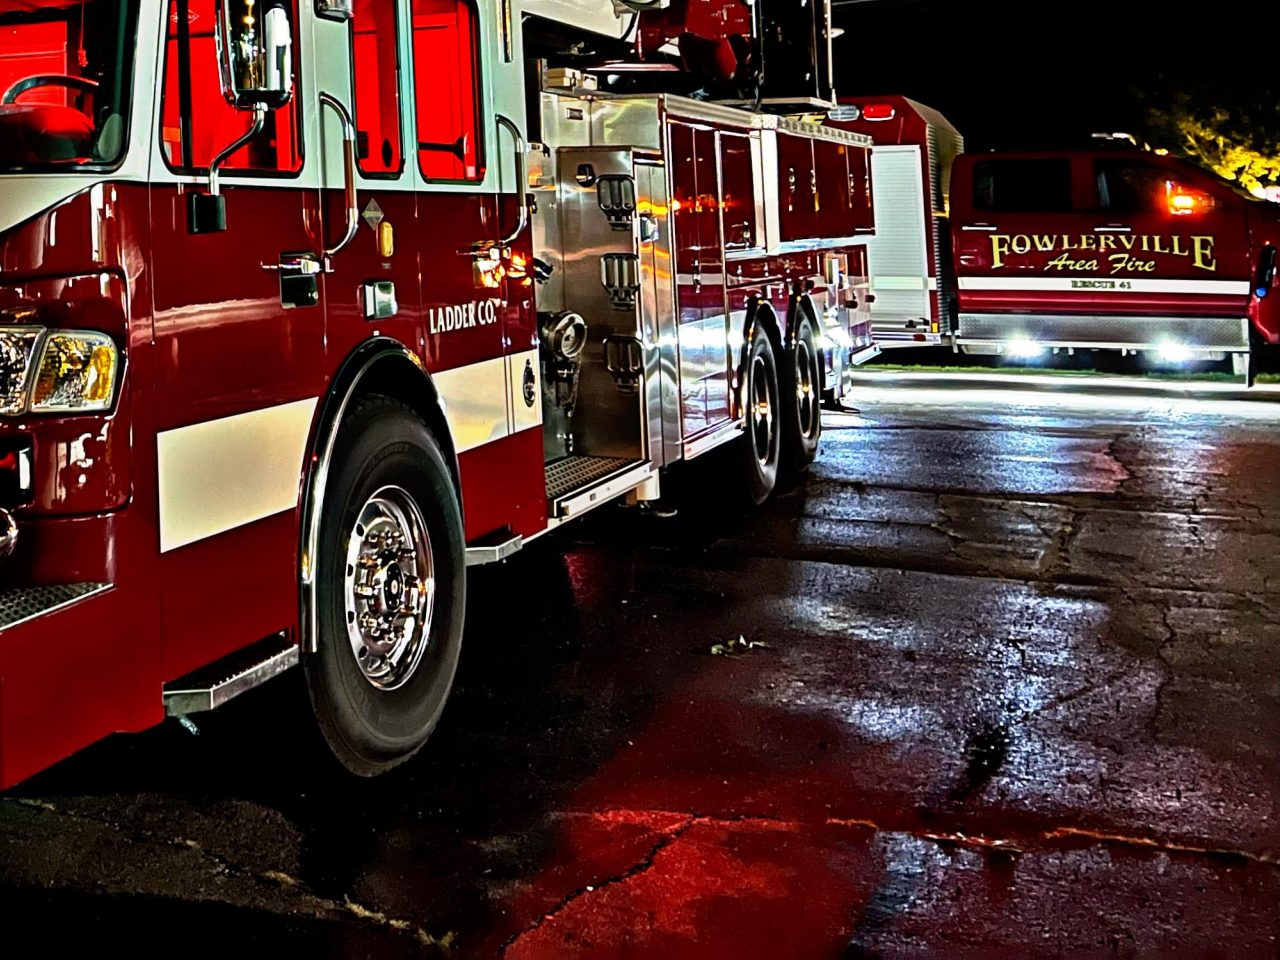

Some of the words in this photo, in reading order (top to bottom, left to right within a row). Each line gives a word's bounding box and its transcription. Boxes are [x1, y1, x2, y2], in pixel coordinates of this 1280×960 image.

[989, 234, 1217, 272] FOWLERVILLE
[1043, 252, 1100, 271] Area
[1108, 253, 1156, 275] Fire
[1071, 280, 1115, 289] RESCUE
[429, 303, 476, 334] LADDER
[478, 300, 497, 325] CO.
